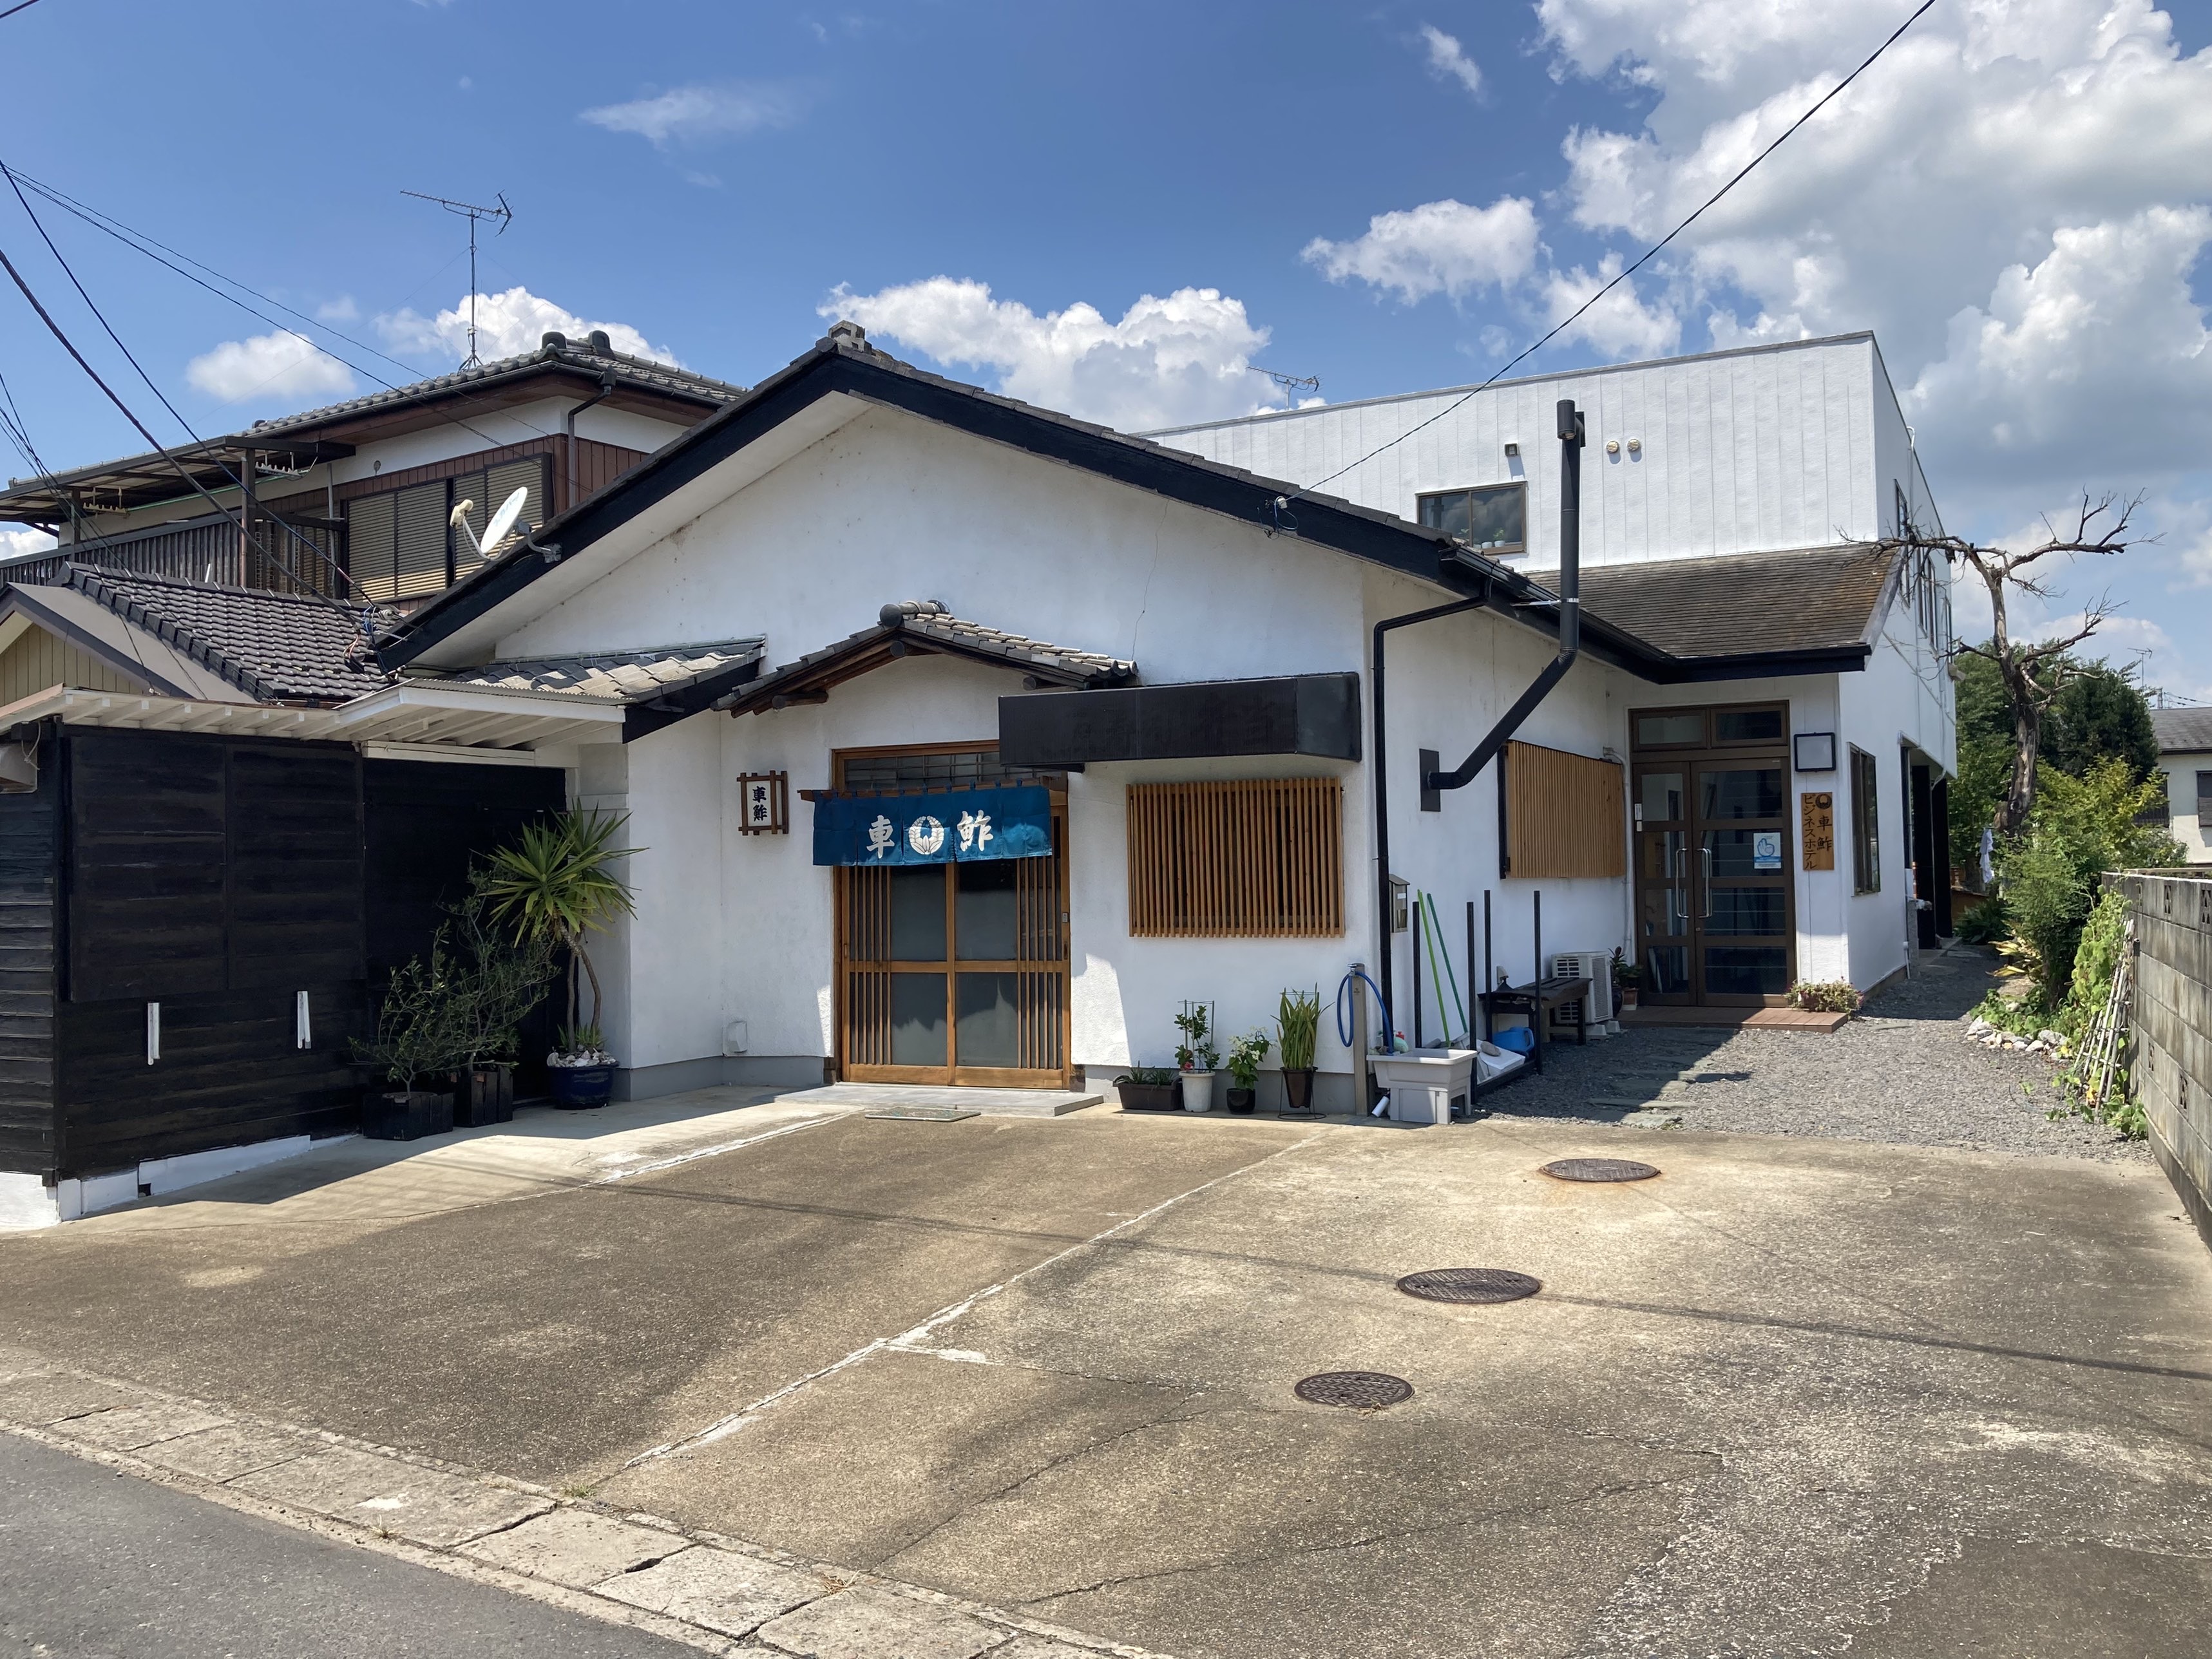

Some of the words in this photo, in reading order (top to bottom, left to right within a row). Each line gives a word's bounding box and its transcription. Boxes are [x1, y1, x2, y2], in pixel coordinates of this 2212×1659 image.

[752, 786, 767, 822] 車鮓
[1804, 793, 1816, 869] ビジネスホテル
[1816, 815, 1833, 851] 車鮓
